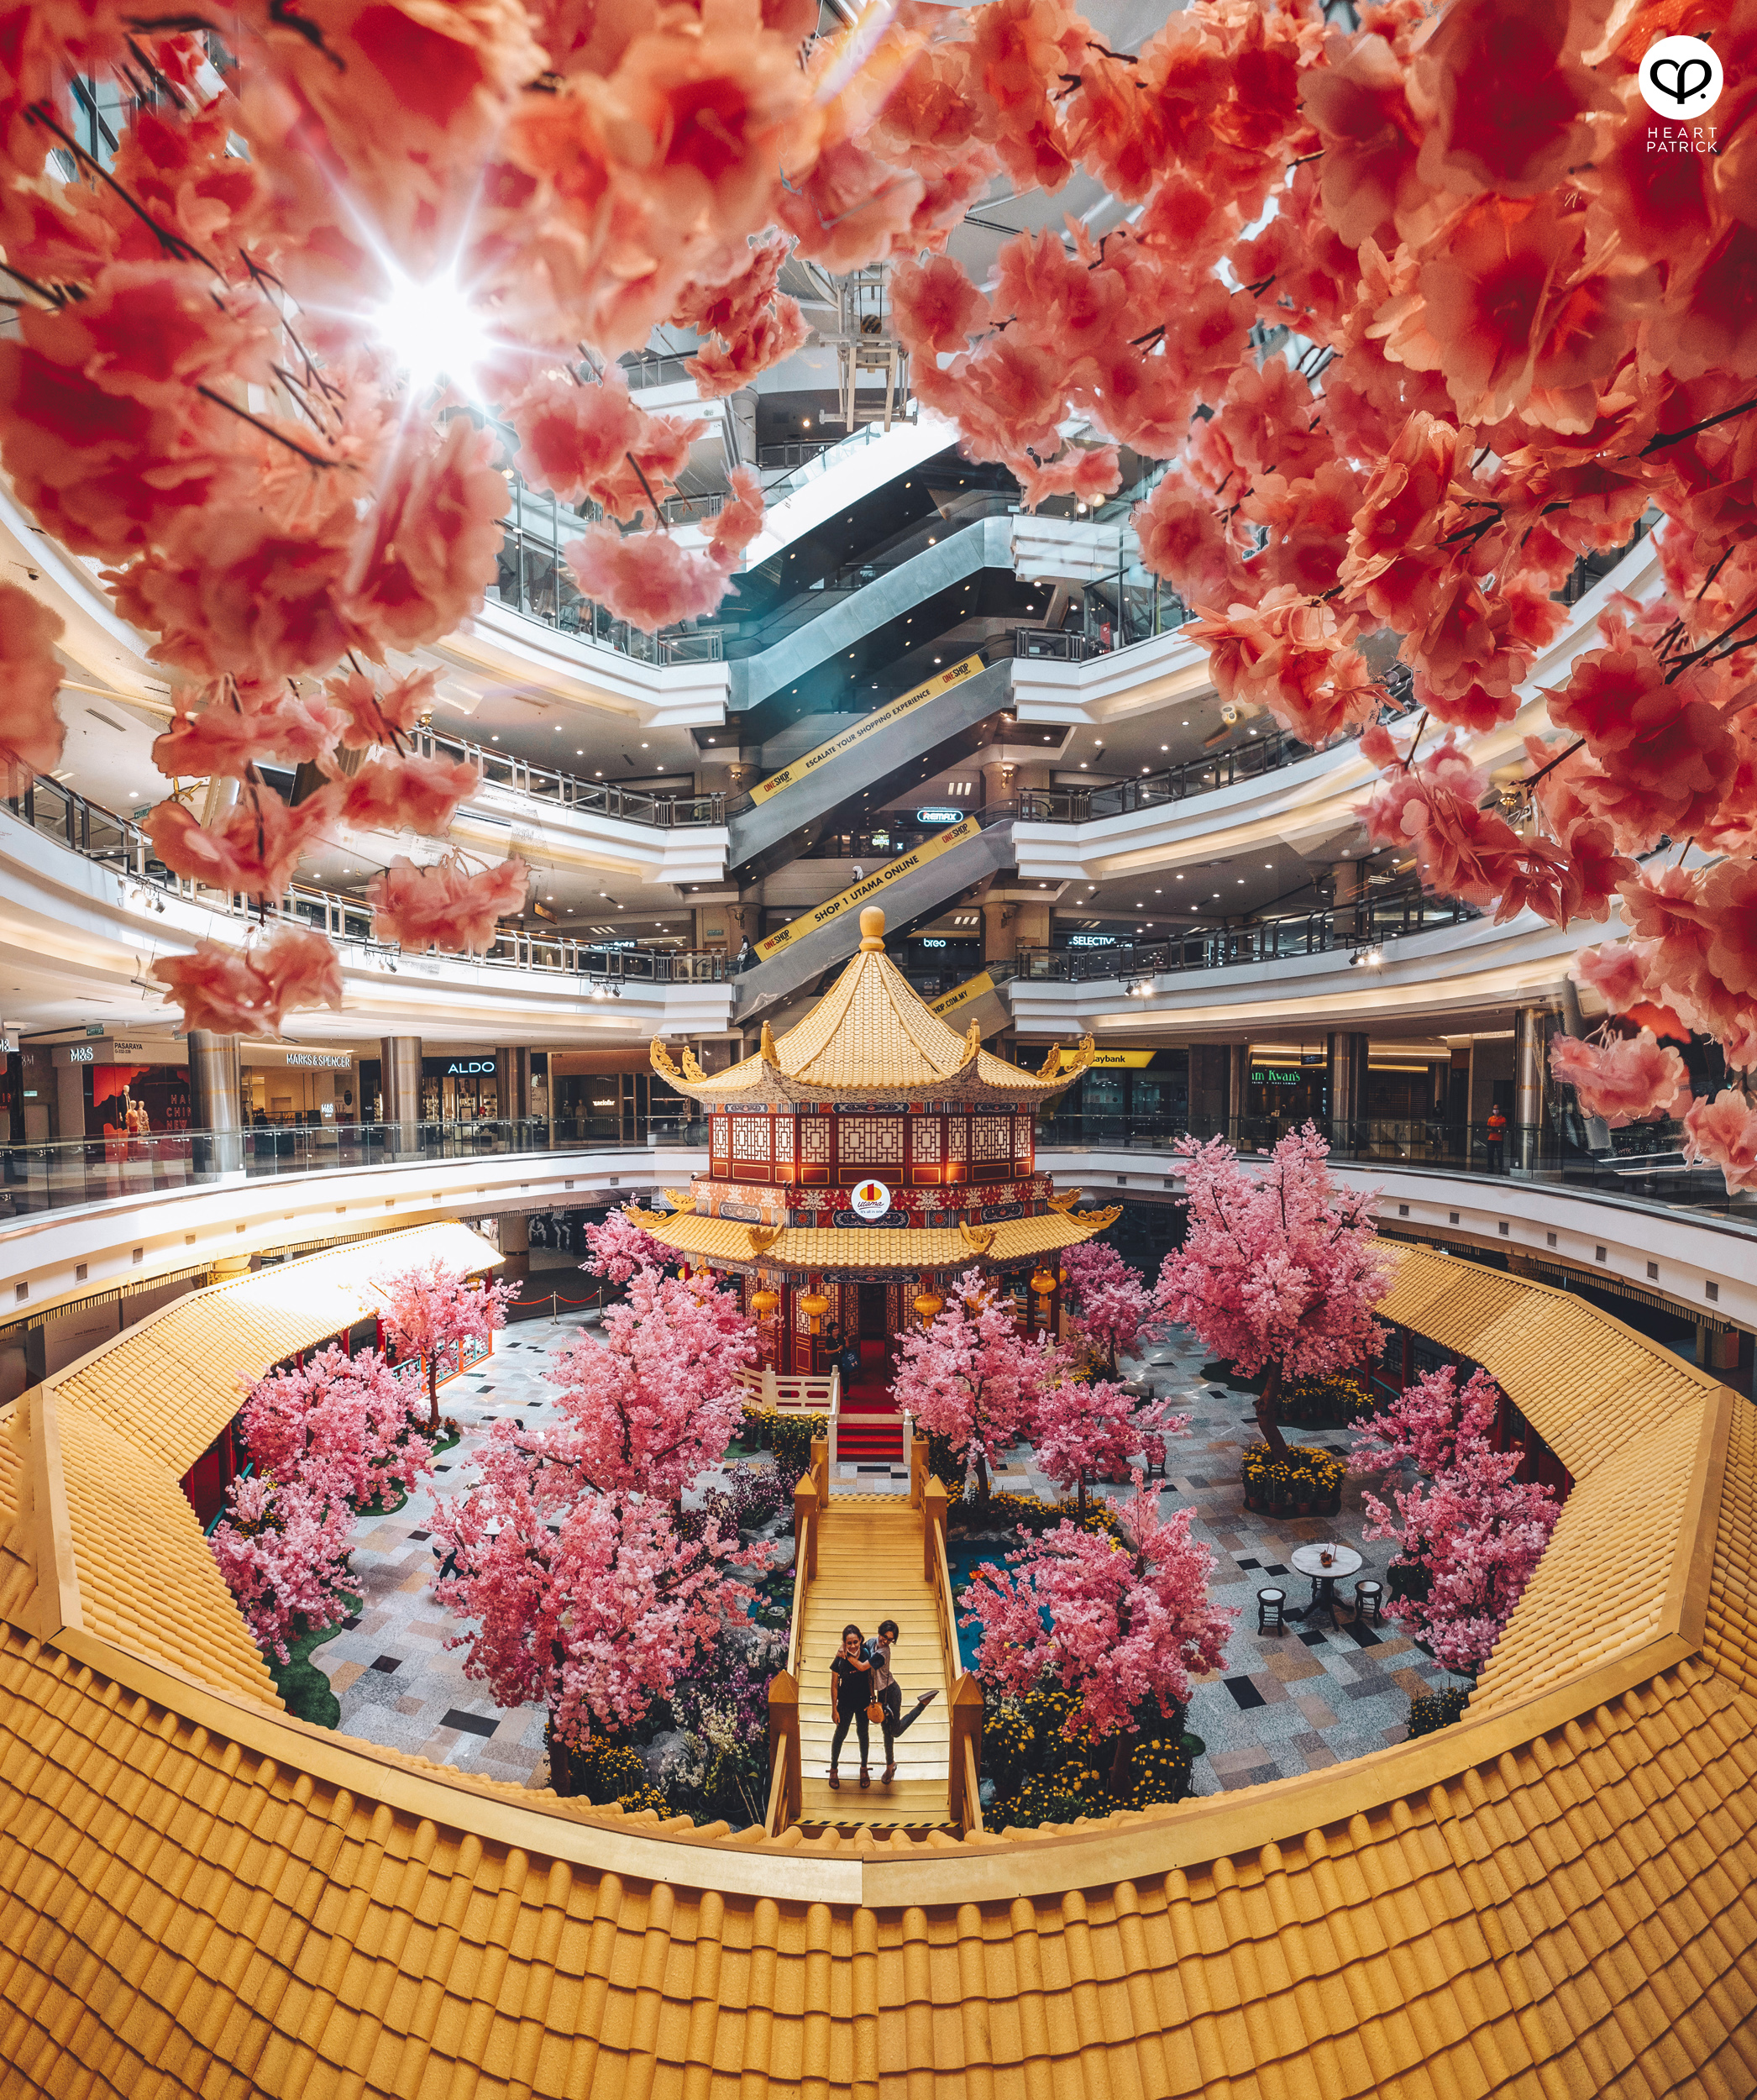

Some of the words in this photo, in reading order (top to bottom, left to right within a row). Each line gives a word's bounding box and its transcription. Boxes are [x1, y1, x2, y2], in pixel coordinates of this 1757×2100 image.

[942, 663, 968, 683] ONESHOP
[805, 746, 837, 768] ESCALATE
[837, 733, 857, 748] YOUR
[857, 712, 891, 737] SHOPPING
[892, 689, 931, 715] EXPERIENCE
[763, 770, 789, 792] ONESHOP
[922, 811, 957, 821] REMAX
[941, 823, 968, 843] ONESHOP
[815, 902, 841, 922] SHOP
[850, 877, 884, 900] UTAMA
[884, 855, 920, 879] ONLINE
[763, 929, 789, 950] ONESHOP
[923, 937, 947, 948] breo
[1073, 936, 1115, 946] SELECTIV
[70, 1047, 94, 1062] M&S
[286, 1053, 312, 1066] MARKS
[312, 1055, 318, 1066] &
[318, 1055, 351, 1068] SPENCER
[1094, 1055, 1125, 1063] aybank
[448, 1061, 496, 1074] ALDO
[1268, 1069, 1301, 1082] Kwan's
[166, 1120, 187, 1130] NEW
